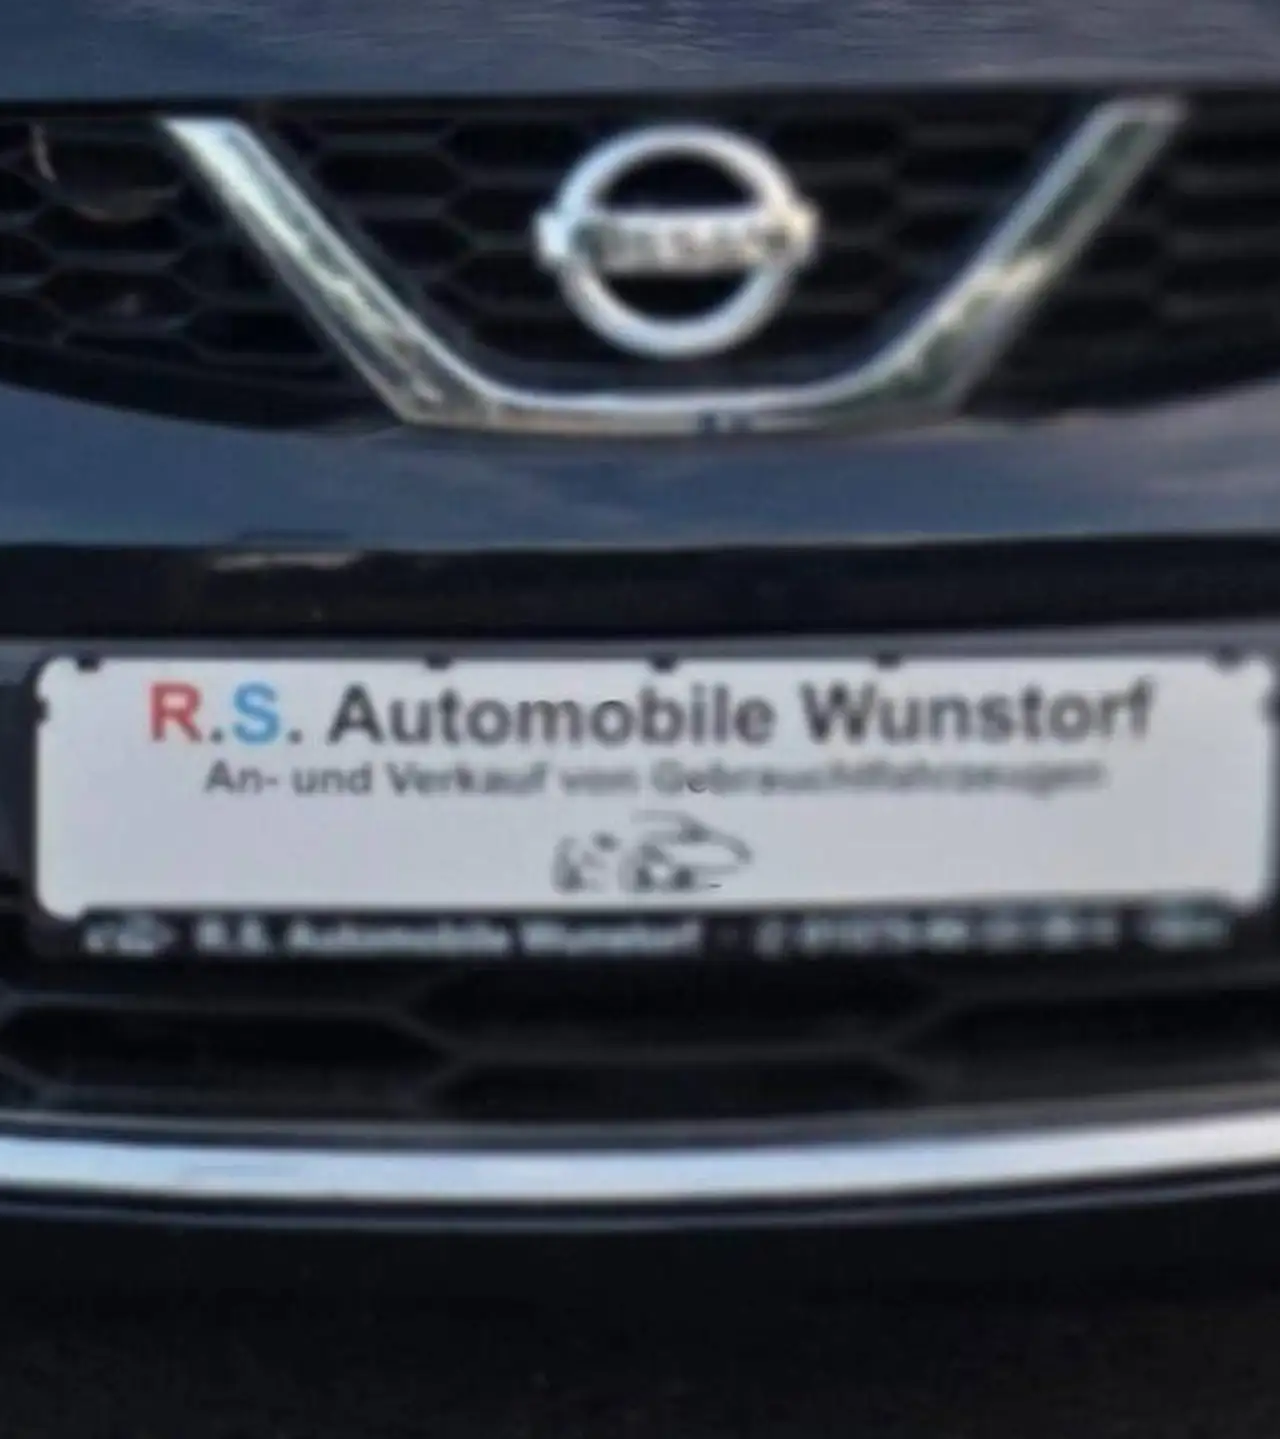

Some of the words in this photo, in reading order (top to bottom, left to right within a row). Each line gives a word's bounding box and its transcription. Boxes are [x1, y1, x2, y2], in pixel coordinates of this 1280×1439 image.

[149, 682, 304, 746] R.S.
[326, 681, 777, 747] Automobile
[799, 676, 1157, 744] Wunstorf
[204, 762, 277, 796] An-
[291, 762, 374, 796] und
[386, 762, 548, 796] Verkauf
[559, 768, 638, 796] von
